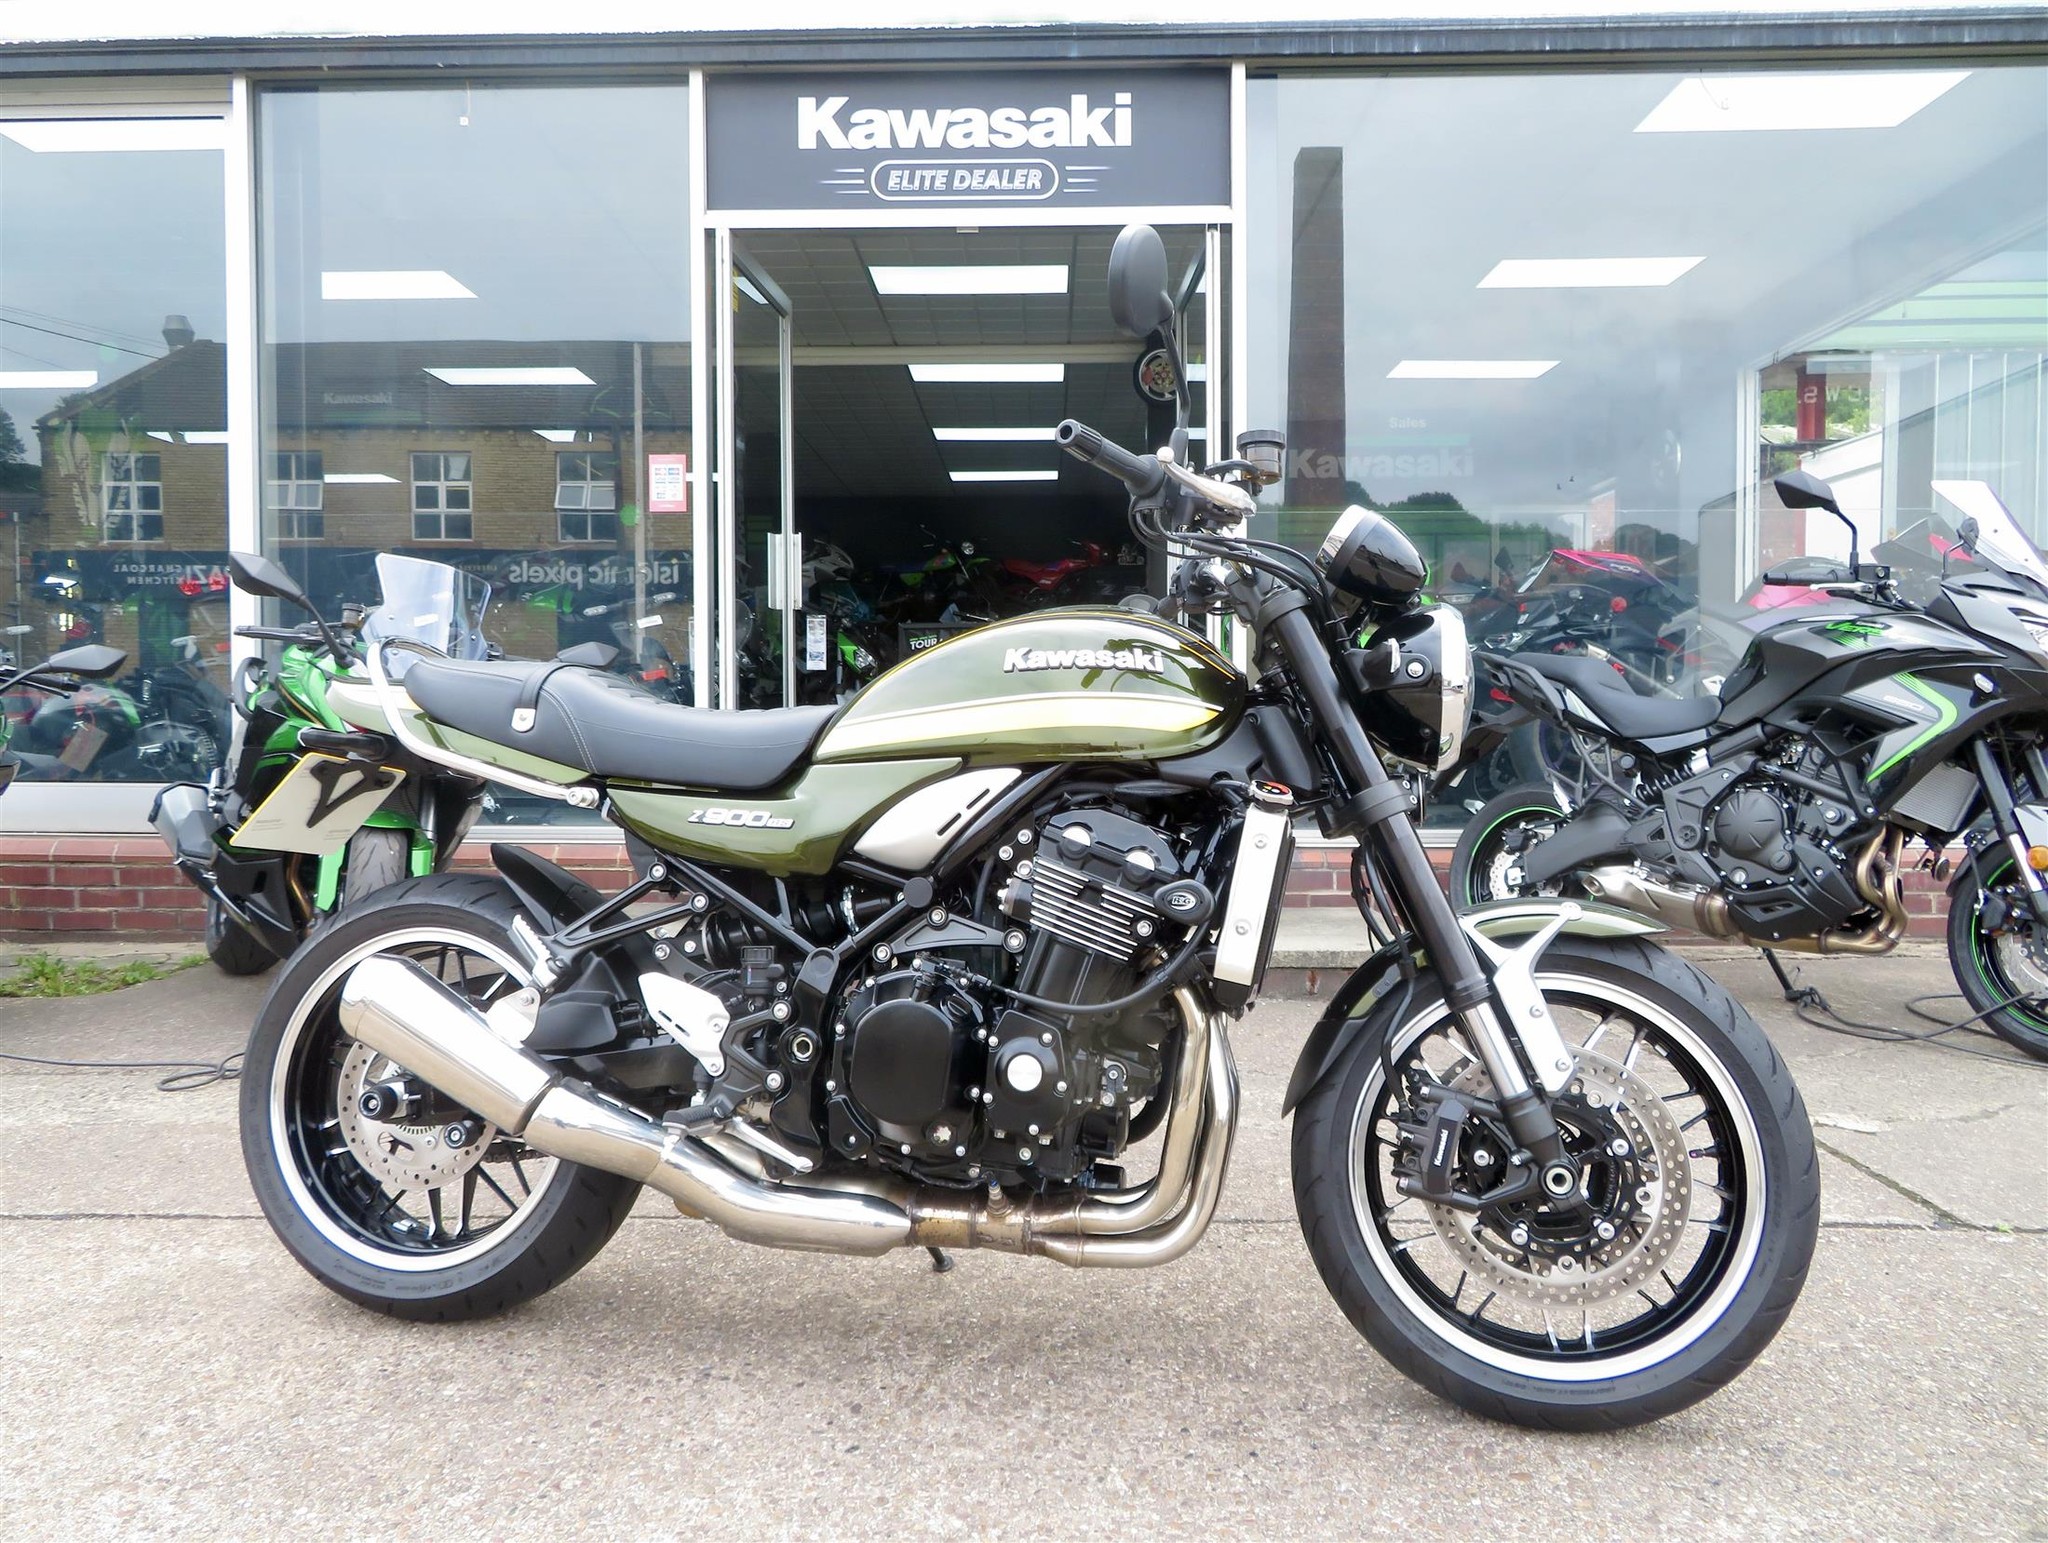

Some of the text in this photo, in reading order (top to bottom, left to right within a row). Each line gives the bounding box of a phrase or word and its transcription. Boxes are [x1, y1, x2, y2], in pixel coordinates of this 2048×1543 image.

[798, 92, 1132, 150] Kawasaki
[887, 168, 1042, 191] ELITE DEALER
[1389, 417, 1427, 429] Sales
[1288, 448, 1475, 479] Kawasaki
[910, 638, 938, 650] TOUR
[1003, 646, 1165, 675] Kawasaki
[1433, 1128, 1449, 1167] Kawasaki
